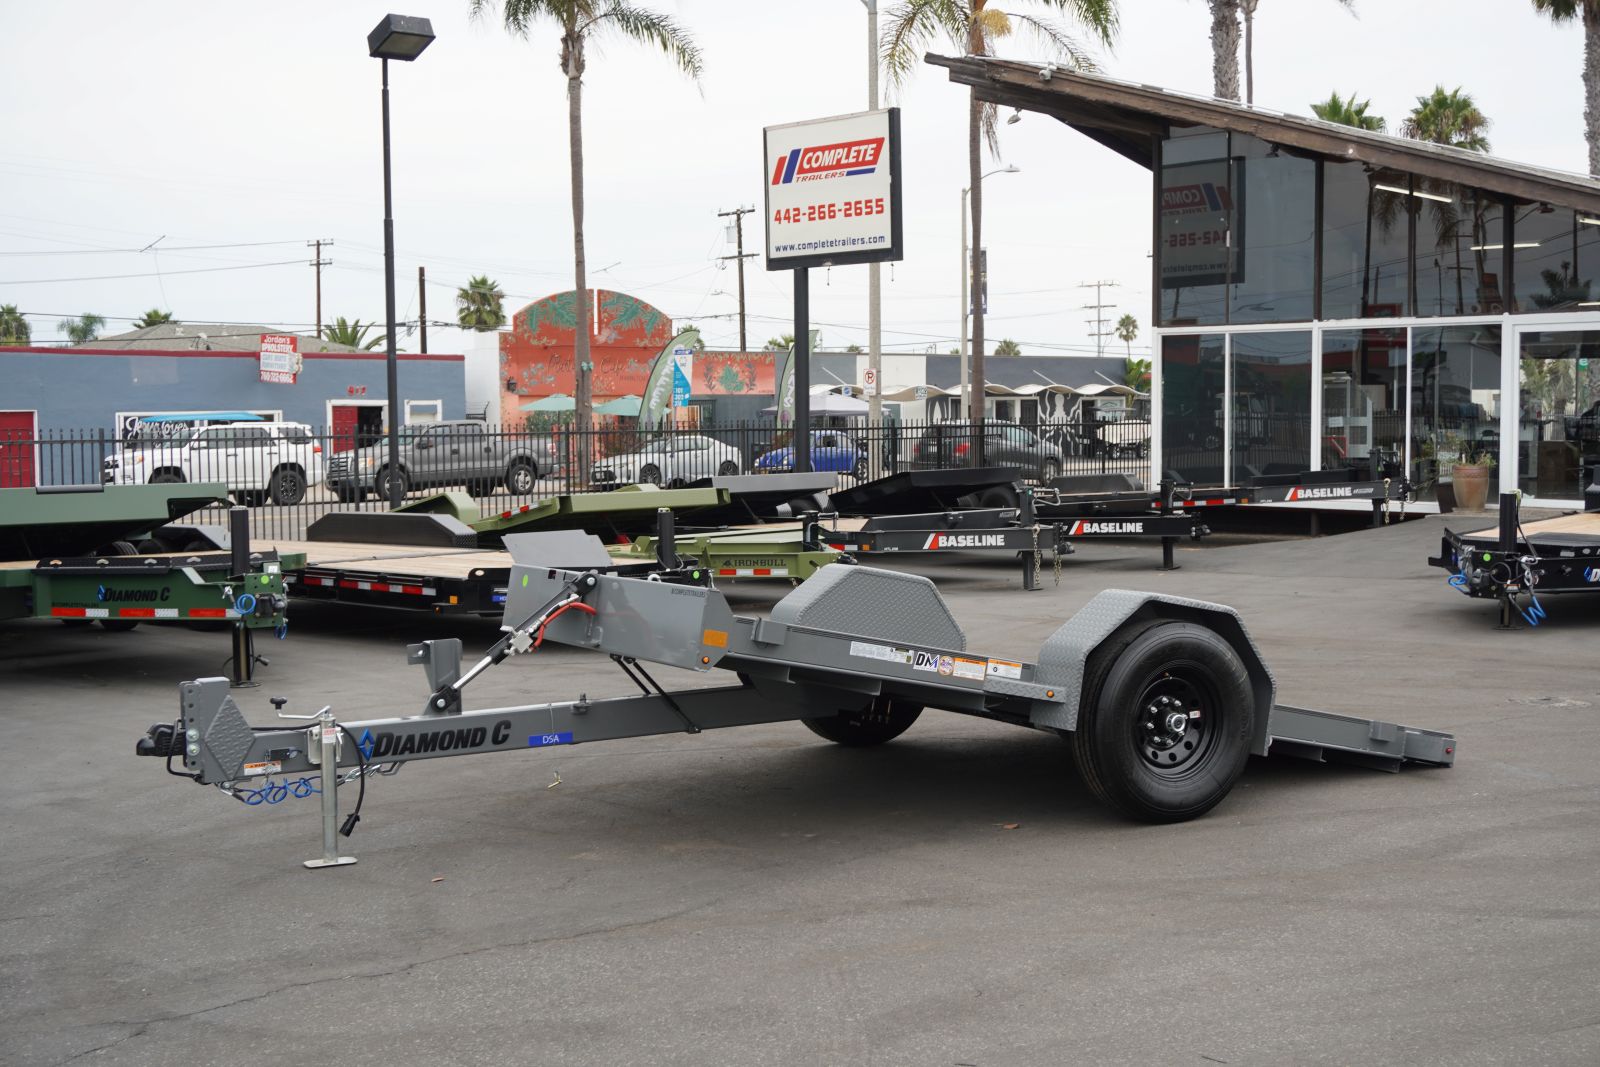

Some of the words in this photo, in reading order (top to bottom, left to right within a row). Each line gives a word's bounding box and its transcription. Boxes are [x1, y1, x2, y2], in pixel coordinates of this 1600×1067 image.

[802, 143, 877, 169] COMPLETE
[796, 170, 845, 183] TRAILERS
[774, 198, 885, 225] 442-266-2655
[775, 235, 885, 252] www.completetrailers.com
[263, 334, 290, 344] Jordan's
[1297, 487, 1352, 498] BASELINE
[1083, 522, 1143, 533] BASELINE
[938, 534, 1005, 547] BASELINE
[734, 559, 786, 567] IRONBULL
[159, 587, 170, 602] C
[916, 653, 938, 668] DM
[491, 719, 512, 745] C
[542, 735, 560, 744] DSA
